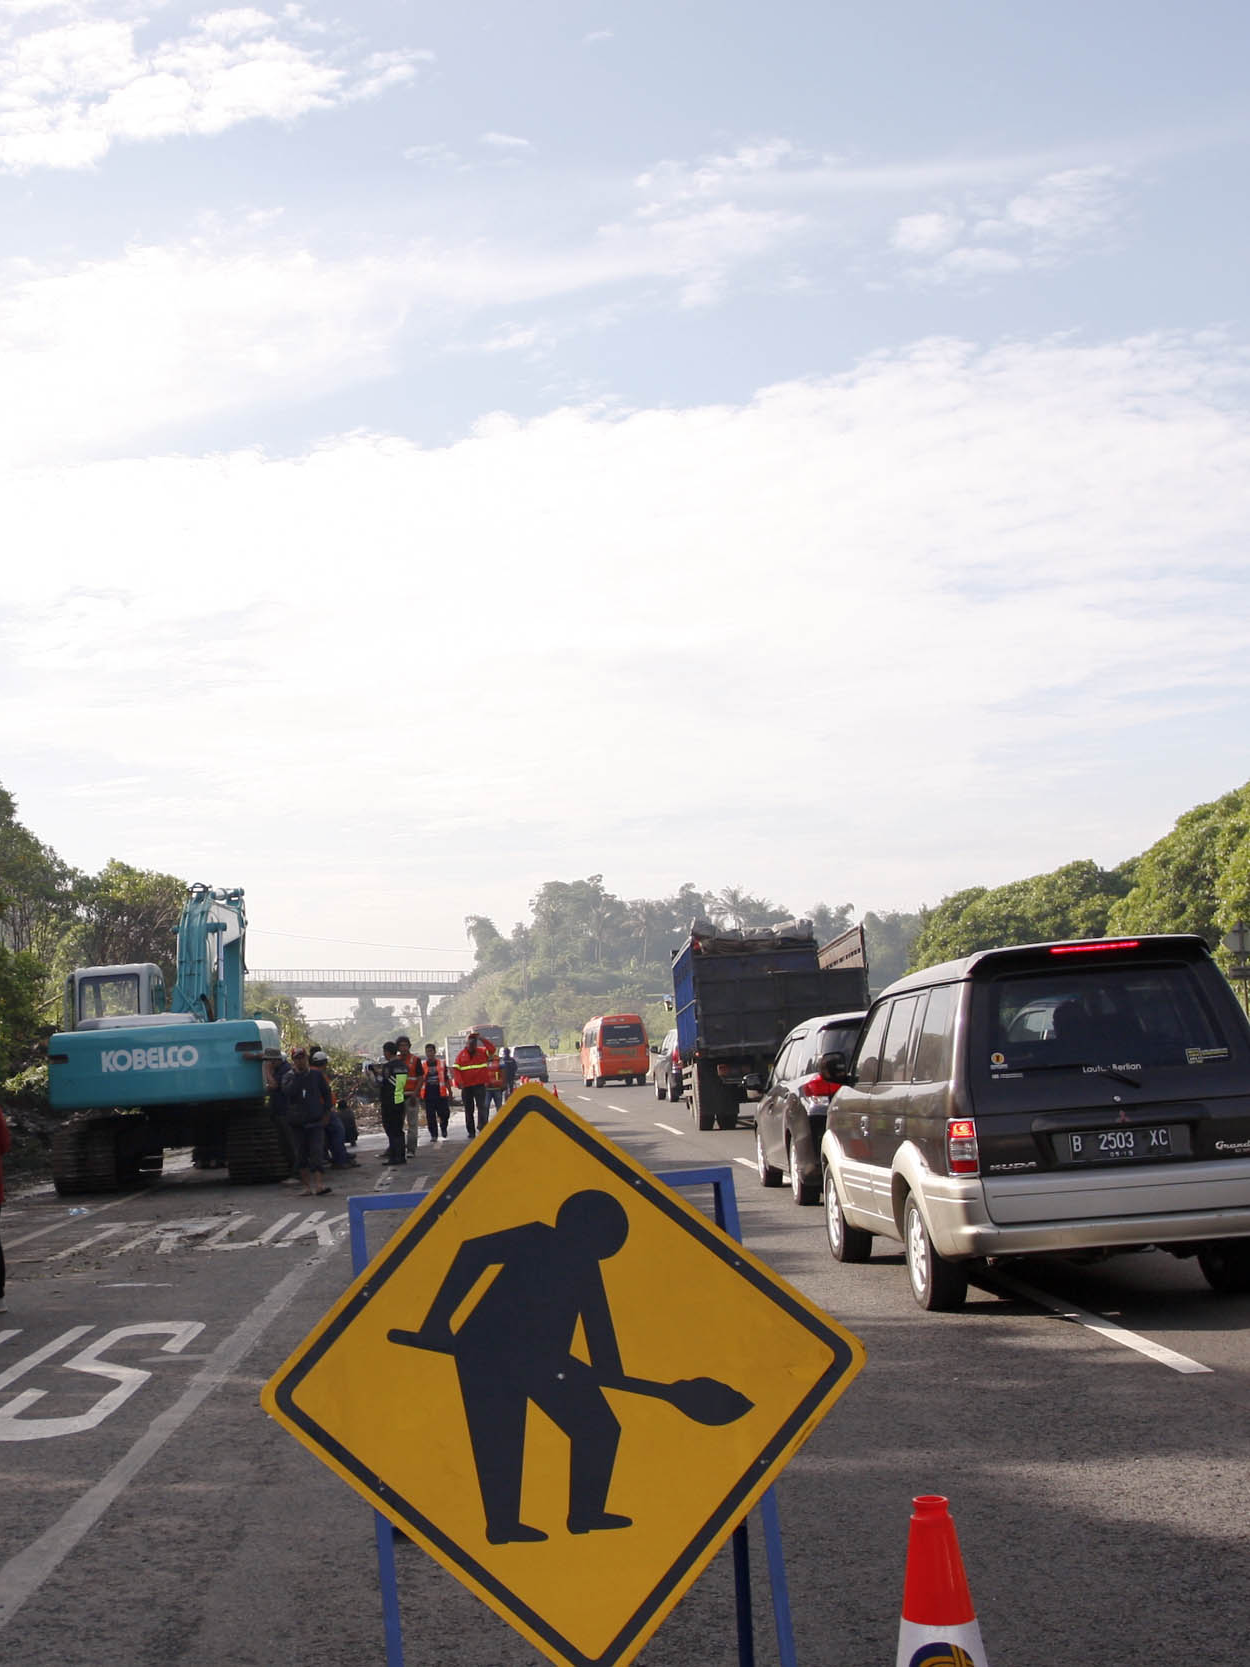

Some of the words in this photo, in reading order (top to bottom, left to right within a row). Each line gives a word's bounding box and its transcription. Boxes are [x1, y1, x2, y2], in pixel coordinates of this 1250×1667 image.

[101, 1045, 199, 1072] KOBELCO
[1082, 1064, 1111, 1073] Laut
[1072, 1135, 1082, 1152] B
[1098, 1131, 1135, 1150] 2503
[1150, 1128, 1168, 1146] XC
[989, 1161, 1037, 1171] KUDA
[47, 1210, 348, 1258] TRUK
